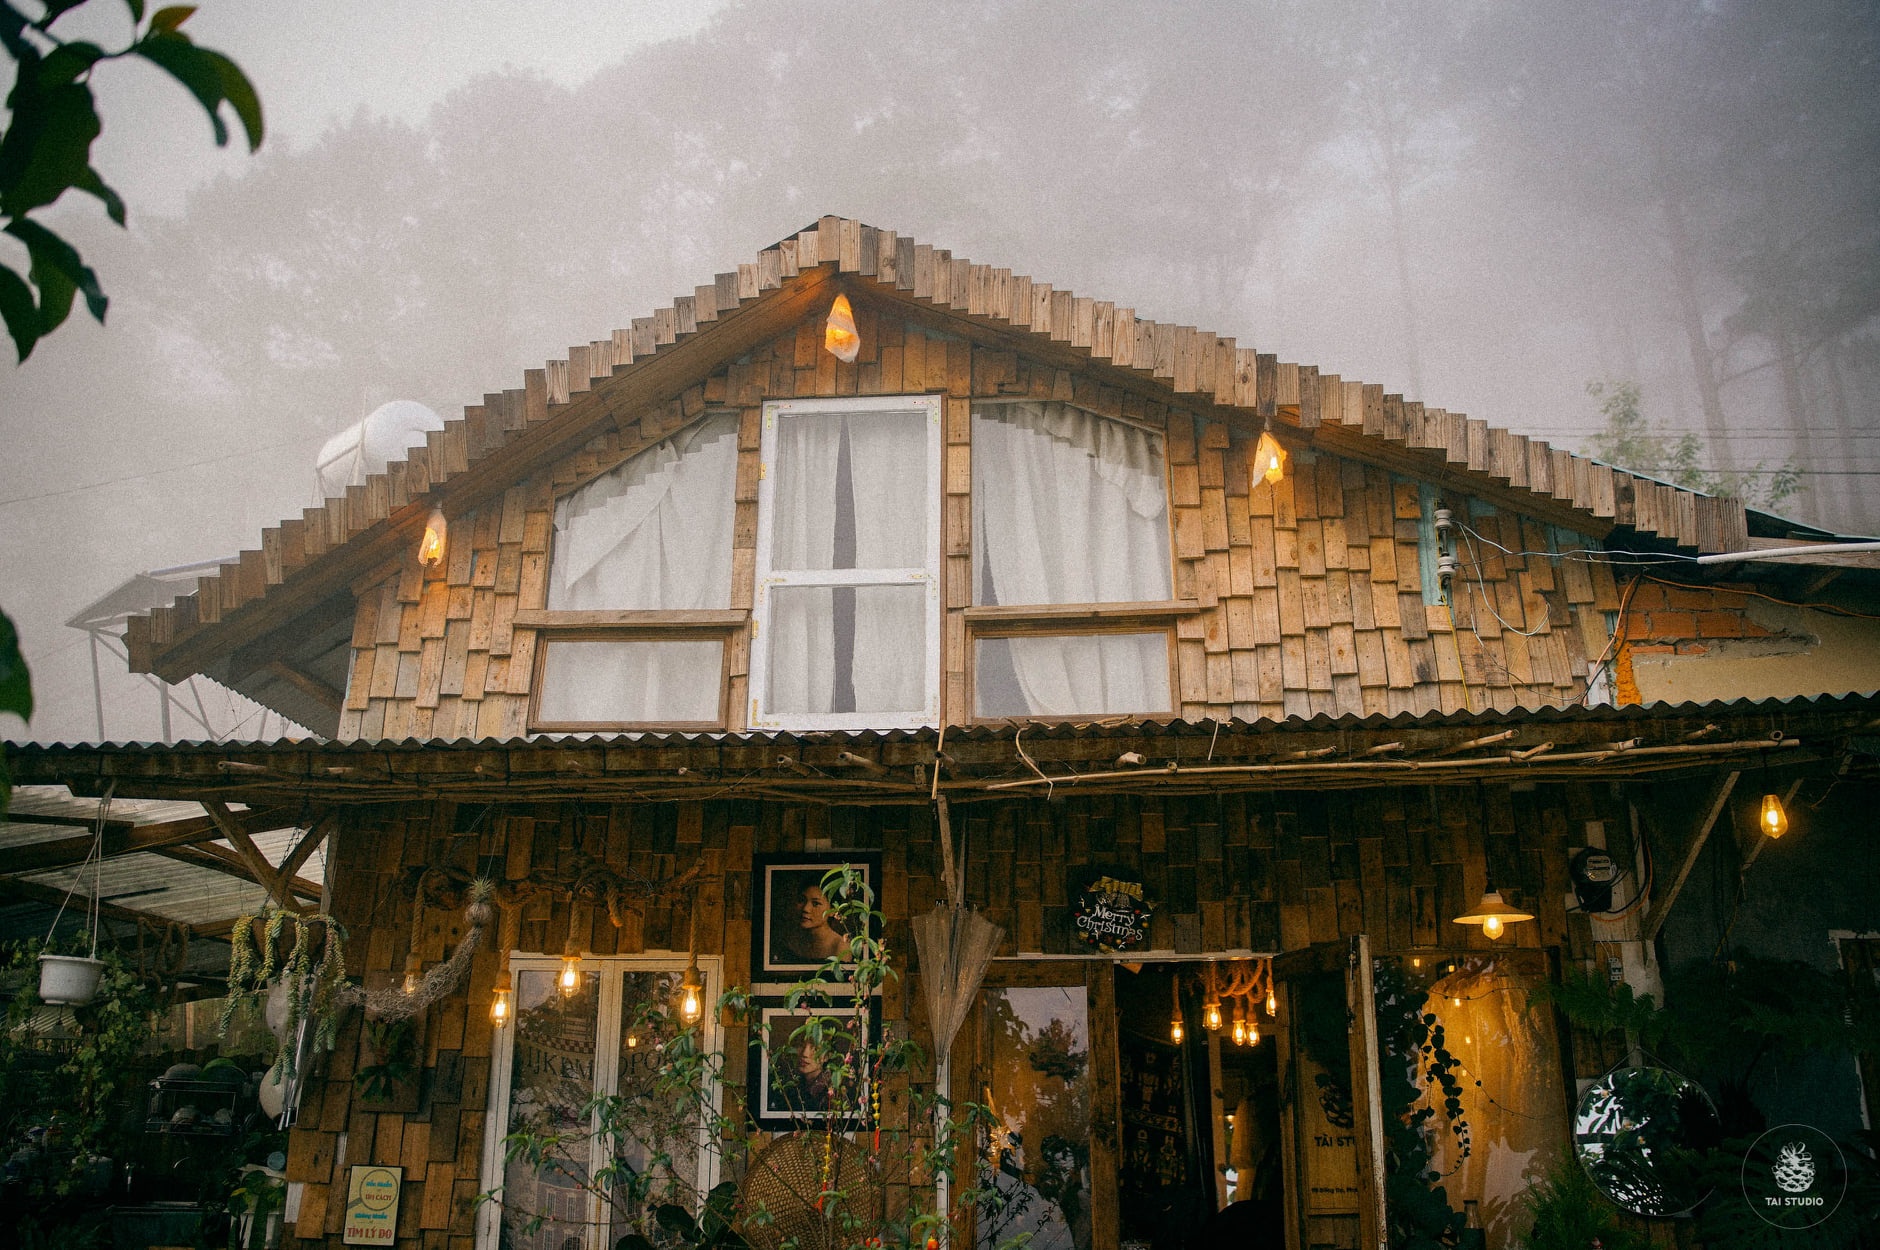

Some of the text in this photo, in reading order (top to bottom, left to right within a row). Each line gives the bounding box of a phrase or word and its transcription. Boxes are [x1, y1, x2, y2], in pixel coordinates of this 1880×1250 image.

[1092, 903, 1135, 927] Merry
[1076, 915, 1143, 941] Christmas
[1337, 1136, 1356, 1147] ST
